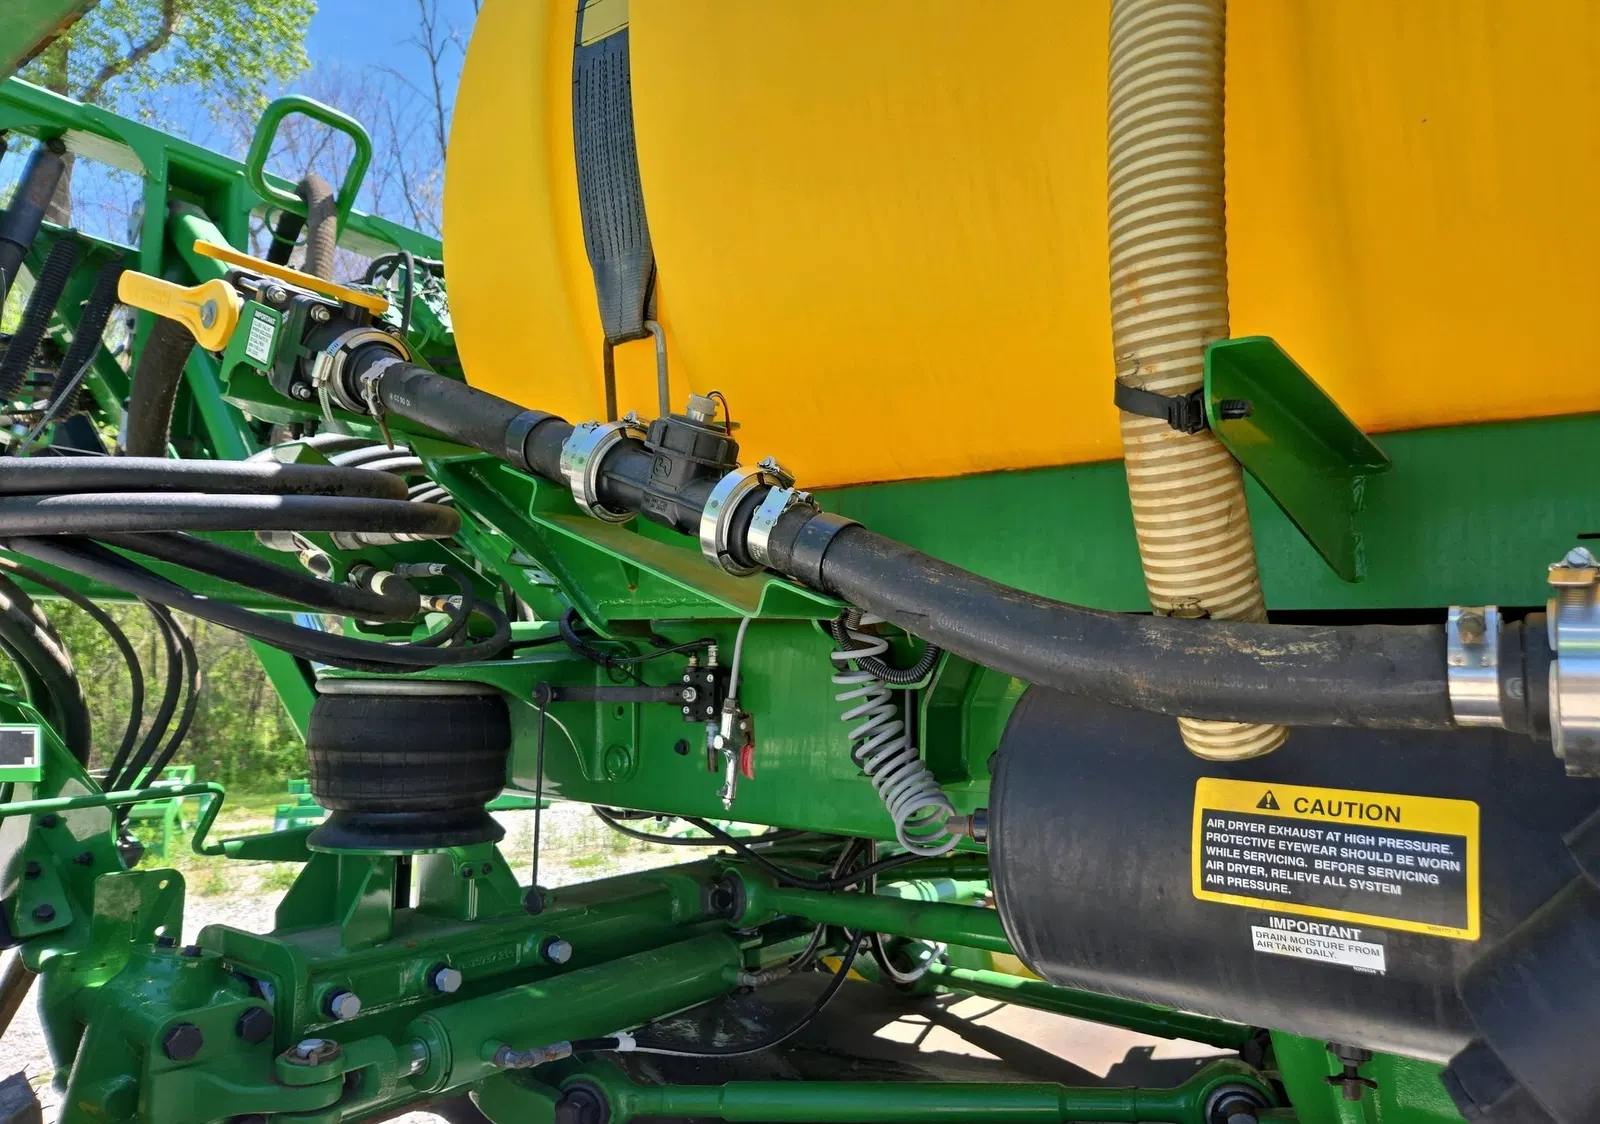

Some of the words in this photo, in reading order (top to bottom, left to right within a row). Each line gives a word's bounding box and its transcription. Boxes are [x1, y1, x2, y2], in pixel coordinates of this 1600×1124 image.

[1294, 797, 1400, 823] CAUTION
[1206, 818, 1225, 829] AIR
[1228, 820, 1266, 833] DRYER
[1268, 825, 1323, 840] EXHAUST
[1326, 831, 1342, 842] AT
[1344, 834, 1375, 846] HIGH
[1378, 837, 1454, 855] PRESSURE.
[1206, 832, 1276, 849] PROTECTIVE
[1278, 840, 1337, 857] EYEWEAR
[1340, 848, 1393, 863] SHOULD
[1396, 854, 1414, 866] BE
[1418, 856, 1461, 872] WORN
[1206, 846, 1240, 858] WHILE
[1243, 850, 1308, 868] SERVICING.
[1314, 859, 1365, 875] BEFORE
[1368, 866, 1440, 885] SERVICING
[1206, 860, 1224, 871] AIR
[1227, 862, 1268, 878] DRYER,
[1271, 868, 1320, 884] RELIEVE
[1323, 876, 1346, 888] ALL
[1349, 878, 1402, 895] SYSTEM
[1206, 874, 1224, 885] AIR
[1227, 876, 1292, 894] PRESSURE.
[1269, 916, 1362, 940] IMPORTANT
[1255, 930, 1287, 942] DRAIN
[1290, 936, 1345, 952] MOISTURE
[1348, 944, 1380, 956] FROM
[1257, 940, 1274, 949] AIR
[1275, 942, 1302, 954] TANK
[1306, 948, 1337, 960] DAILY.
